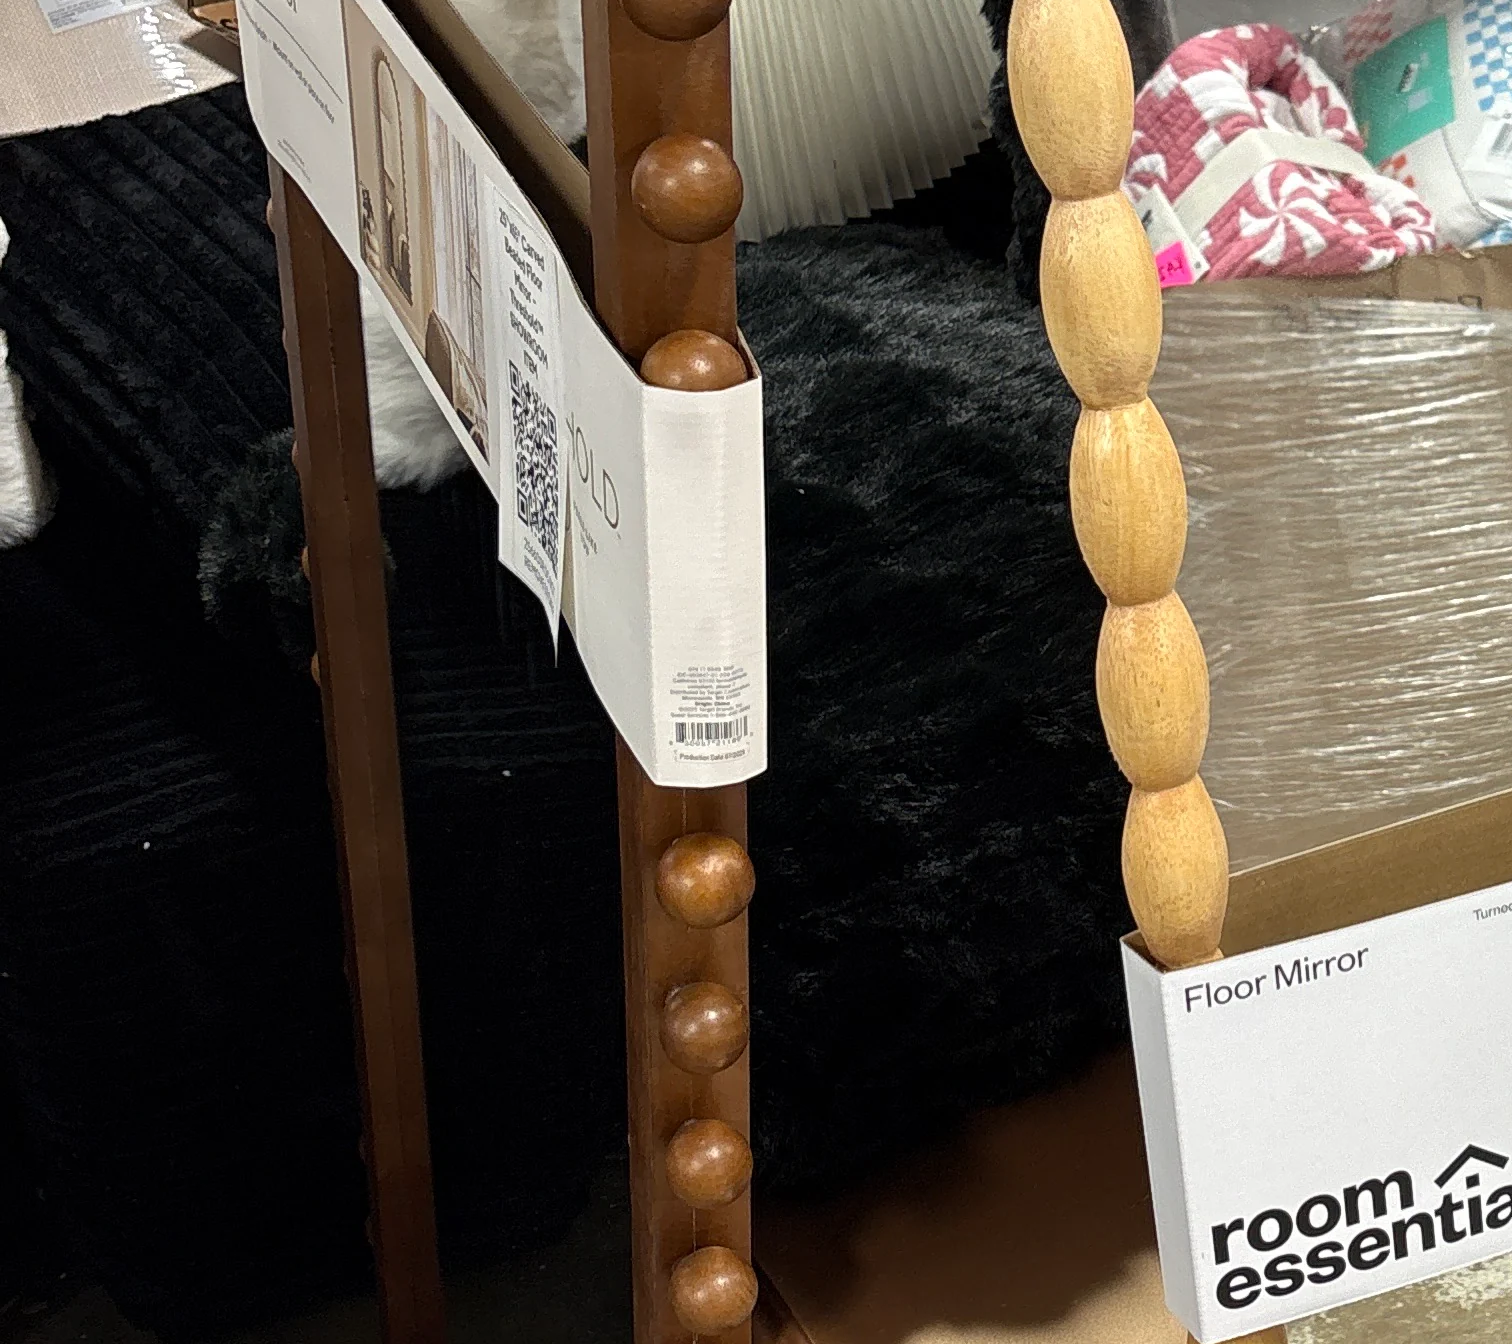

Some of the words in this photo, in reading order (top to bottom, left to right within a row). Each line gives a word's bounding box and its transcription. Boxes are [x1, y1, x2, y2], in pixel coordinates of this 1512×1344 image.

[1184, 973, 1268, 1013] Floor
[1274, 947, 1370, 990] Mirror
[1211, 1169, 1415, 1265] room
